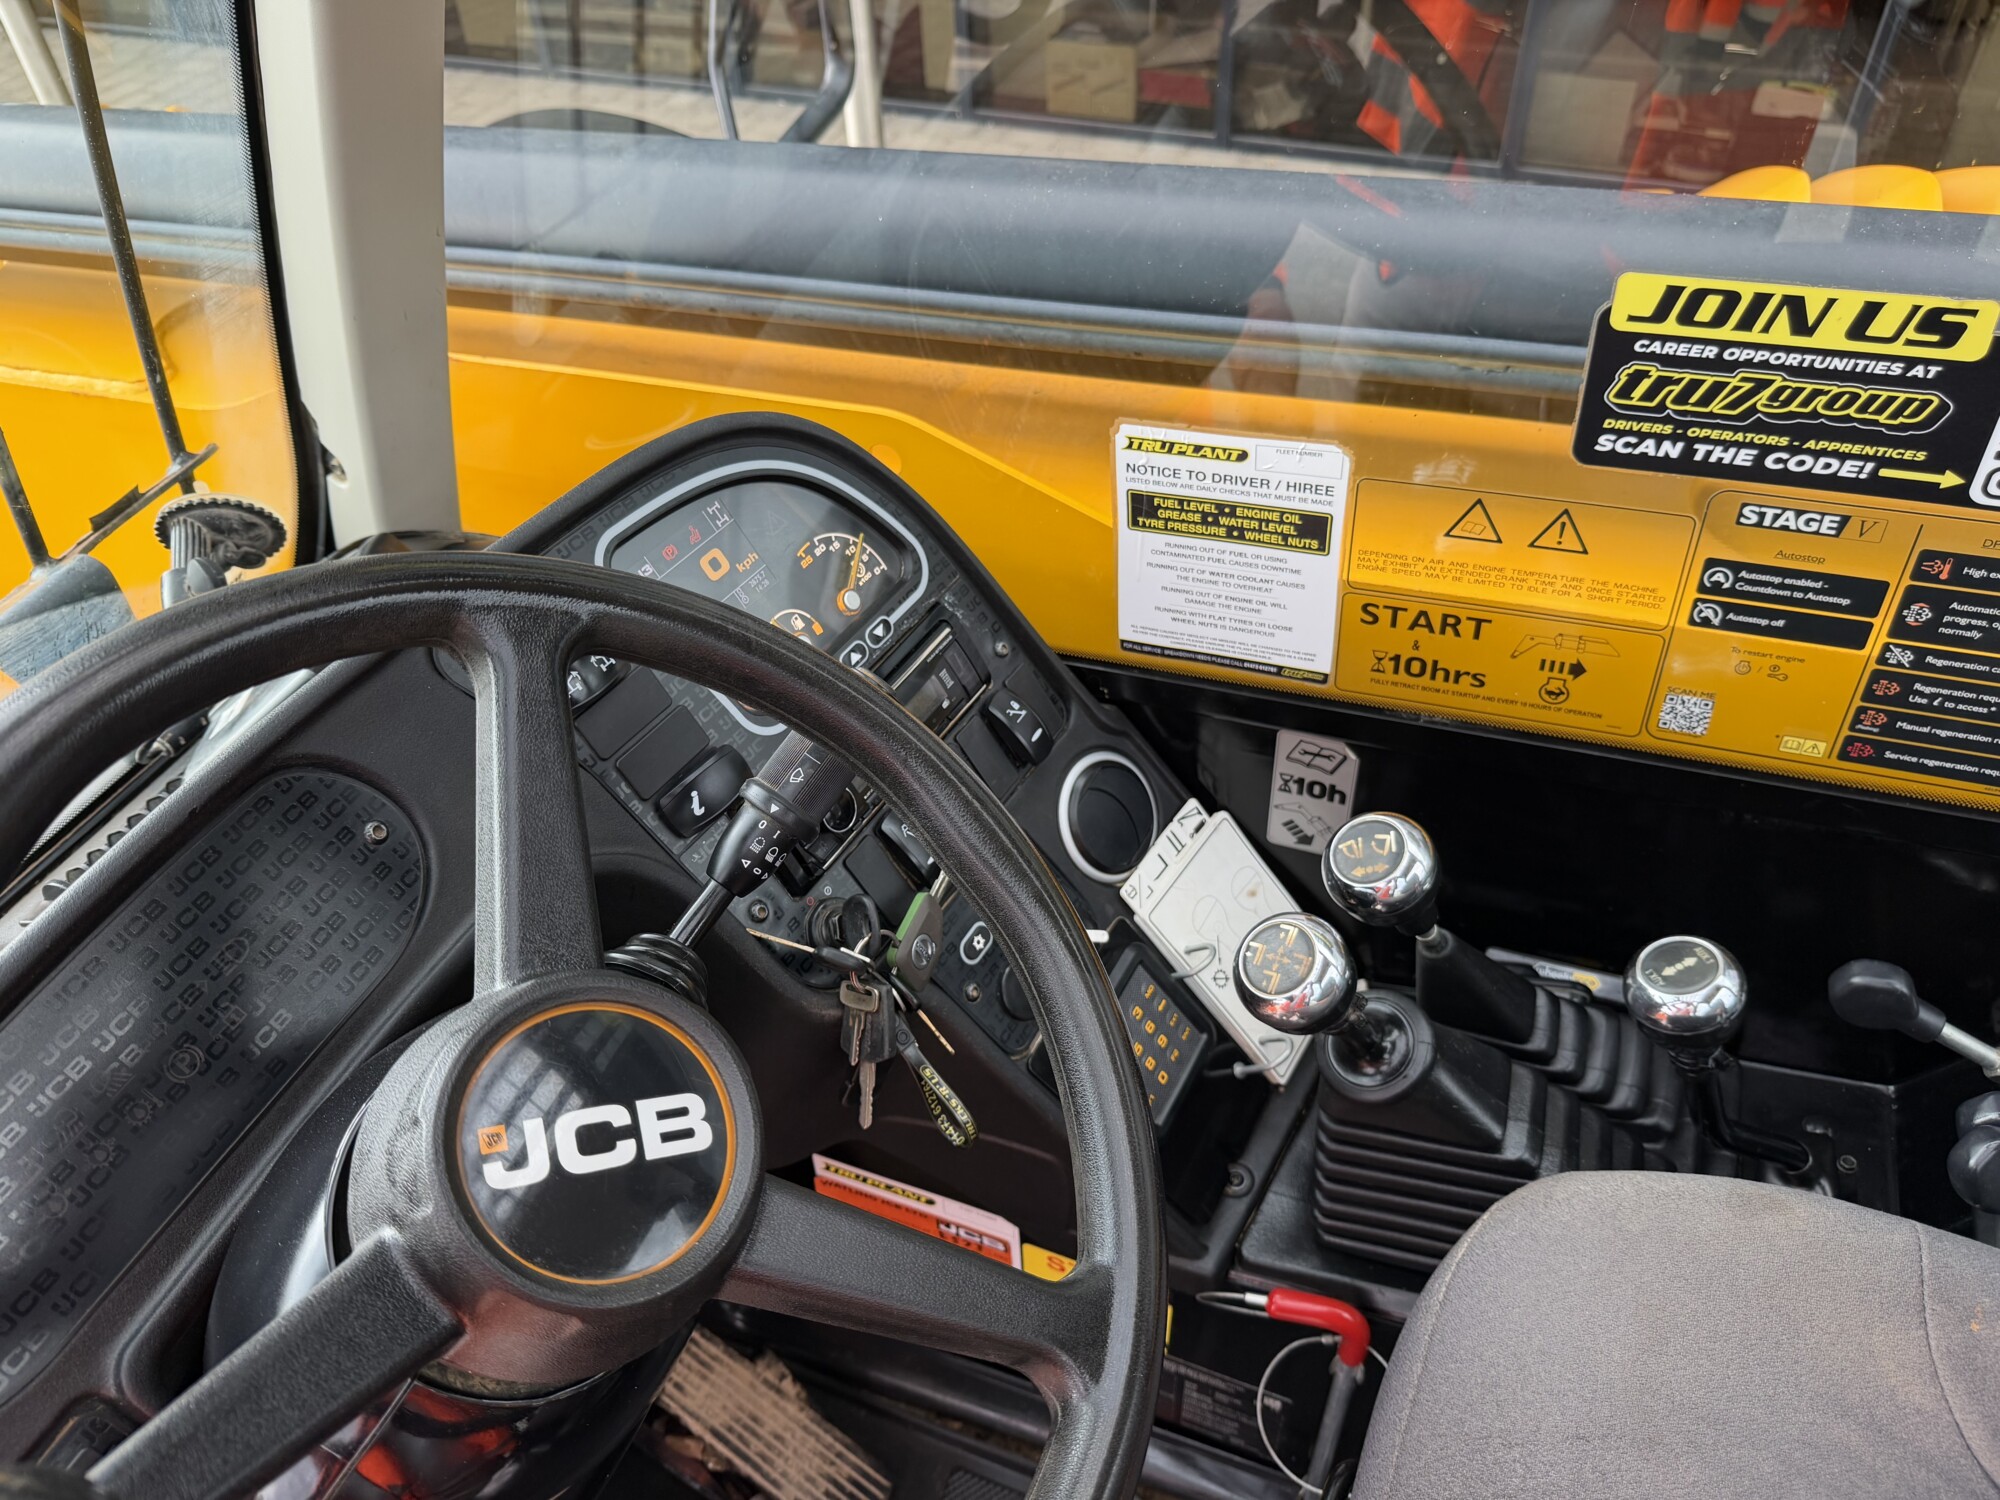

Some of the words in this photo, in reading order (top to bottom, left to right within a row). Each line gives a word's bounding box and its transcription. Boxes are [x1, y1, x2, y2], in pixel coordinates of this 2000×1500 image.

[1627, 285, 1836, 337] JOIN
[1844, 300, 1978, 349] US
[1633, 339, 1718, 358] CAREER
[1722, 347, 1904, 375] OPPORTUNITIES
[1905, 364, 1942, 378] AT
[1609, 363, 1937, 424] tru7group
[1130, 438, 1172, 453] TRU
[1171, 443, 1242, 462] PLANT
[1602, 418, 1673, 434] DRIVERS
[1686, 427, 1790, 446] OPERATORS
[1802, 439, 1927, 461] APPRENTICES
[1594, 433, 1684, 458] SCAN
[1693, 443, 1758, 466] THE
[1764, 452, 1875, 478] CODE!
[1126, 462, 1181, 479] NOTICE
[1185, 469, 1206, 481] TO
[1211, 472, 1270, 489] DRIVER
[1286, 481, 1334, 497] HIREE
[1125, 476, 1150, 484] LISTED
[1152, 479, 1178, 488] BELOW
[1218, 487, 1250, 496] CHECKS
[1253, 491, 1272, 499] THAT
[1273, 494, 1296, 502] MUST
[1310, 498, 1333, 506] MADE
[1153, 497, 1181, 509] FUEL
[1183, 501, 1218, 513] LEVEL
[1235, 507, 1280, 521] ENGINE
[1282, 513, 1302, 524] OIL
[1739, 505, 1840, 534] STAGE
[1137, 517, 1164, 528] TYRE
[1167, 521, 1226, 536] PRESSURE
[1244, 530, 1285, 544] WHEEL
[1287, 536, 1318, 549] NUTS
[1157, 509, 1201, 522] GREASE
[1218, 516, 1259, 529] WATER
[1261, 521, 1297, 535] LEVEL
[1858, 519, 1878, 538] V
[814, 543, 826, 556] 20
[829, 542, 840, 552] 15
[845, 545, 856, 556] 10
[862, 554, 869, 562] 5
[1164, 542, 1197, 551] RUNNING
[1228, 550, 1248, 558] FUEL
[1263, 555, 1287, 564] USING
[1773, 549, 1825, 564] Autostop
[699, 548, 730, 582] 0
[736, 551, 759, 573] kph
[801, 555, 813, 569] 25
[874, 568, 880, 576] 0
[1150, 549, 1205, 561] CONTAMINATED
[1207, 556, 1226, 564] FUEL
[1228, 559, 1259, 569] CAUSES
[1260, 564, 1301, 575] DOWNTIME
[1358, 549, 1407, 561] DEPENDING
[1448, 560, 1468, 568] AND
[1472, 563, 1506, 573] ENGINE
[1511, 568, 1584, 584] TEMPERATURE
[1590, 579, 1609, 587] THE
[1613, 582, 1658, 594] MACHINE
[1962, 566, 1987, 578] High
[1146, 561, 1178, 571] RUNNING
[1208, 570, 1234, 579] WATER
[1236, 574, 1274, 584] COOLANT
[1275, 580, 1305, 589] CAUSES
[1191, 576, 1218, 586] ENGINE
[1233, 583, 1272, 593] OVERHEAT
[1356, 563, 1387, 572] ENGINE
[1391, 567, 1421, 577] SPEED
[1424, 572, 1448, 580] MAY
[1451, 575, 1463, 583] BE
[1467, 577, 1505, 588] LIMITED
[1526, 585, 1547, 594] IDLE
[1551, 588, 1570, 596] FOR
[1586, 593, 1621, 603] SHORT
[1624, 598, 1662, 609] PERIOD.
[1382, 559, 1418, 569] EXHIBIT
[1422, 564, 1436, 572] AN
[1439, 566, 1490, 578] EXTENDED
[1494, 574, 1528, 584] CRANK
[1534, 579, 1556, 587] TIME
[1560, 583, 1582, 591] AND
[1585, 586, 1612, 595] ONCE
[1616, 590, 1666, 602] STARTED
[1737, 570, 1783, 584] Autostop
[1783, 578, 1823, 588] enabled
[1160, 585, 1194, 595] RUNNING
[1224, 595, 1253, 604] ENGINE
[1734, 582, 1791, 596] Countdown
[1804, 592, 1851, 605] Autostop
[1184, 597, 1215, 607] DAMAGE
[1218, 602, 1231, 610] THE
[1233, 605, 1261, 614] ENGINE
[1360, 602, 1492, 640] START
[1725, 612, 1769, 626] Autostop
[1769, 619, 1785, 627] off
[1942, 615, 1988, 627] progress,
[1937, 627, 1982, 639] normally
[1411, 639, 1420, 651] &
[1742, 649, 1773, 659] restart
[1775, 654, 1805, 663] engine
[1388, 653, 1485, 688] 10hrs
[1924, 655, 1989, 671] Regeneration
[1666, 686, 1697, 696] SCAN
[1699, 691, 1716, 699] ME
[1908, 694, 1928, 704] Use
[1913, 682, 1977, 698] Regeneration
[1895, 721, 1931, 733] Manual
[1931, 728, 1992, 742] regeneration
[1883, 750, 1918, 762] Service
[1918, 758, 1979, 772] regeneration
[1293, 777, 1346, 805] 10h
[922, 1068, 939, 1084] US
[482, 1093, 713, 1189] JCB
